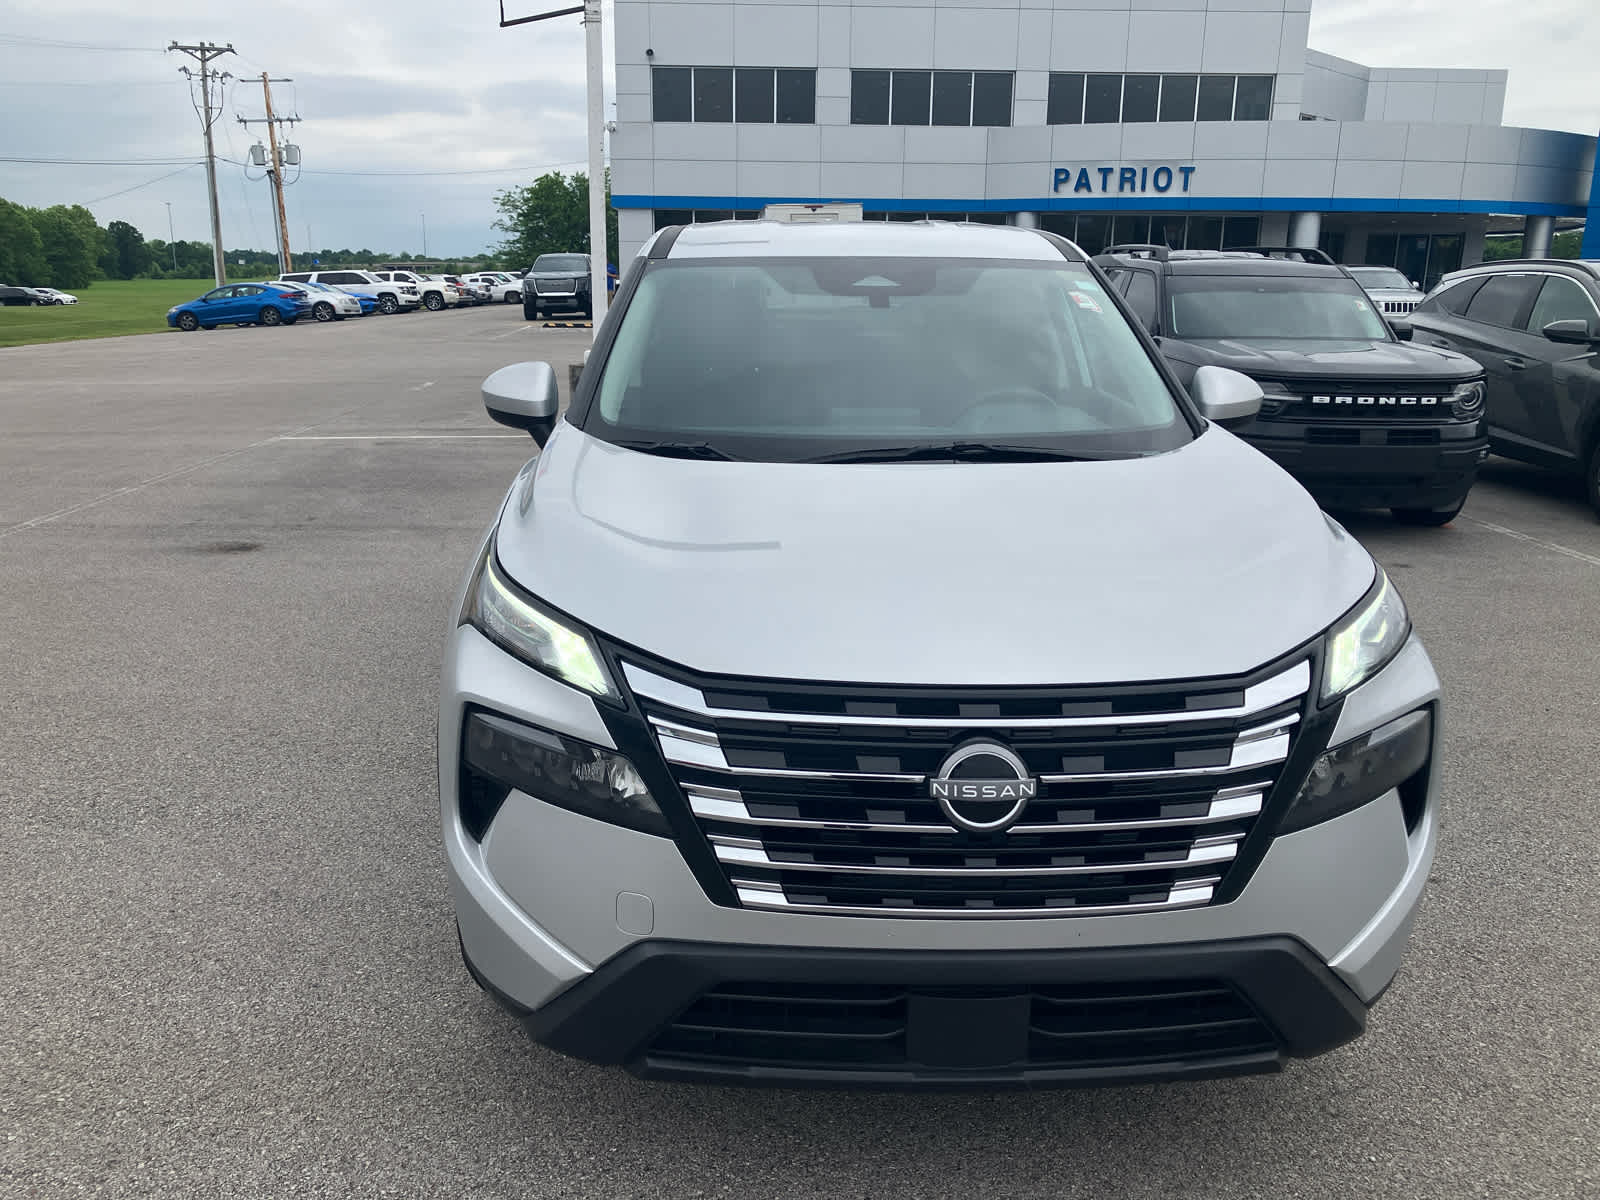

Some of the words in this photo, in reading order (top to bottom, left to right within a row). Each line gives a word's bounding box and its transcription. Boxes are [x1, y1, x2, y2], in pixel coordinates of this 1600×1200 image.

[1053, 166, 1196, 193] PATRIOT
[1312, 396, 1438, 405] BRONCO
[932, 782, 1034, 798] NISSAN
